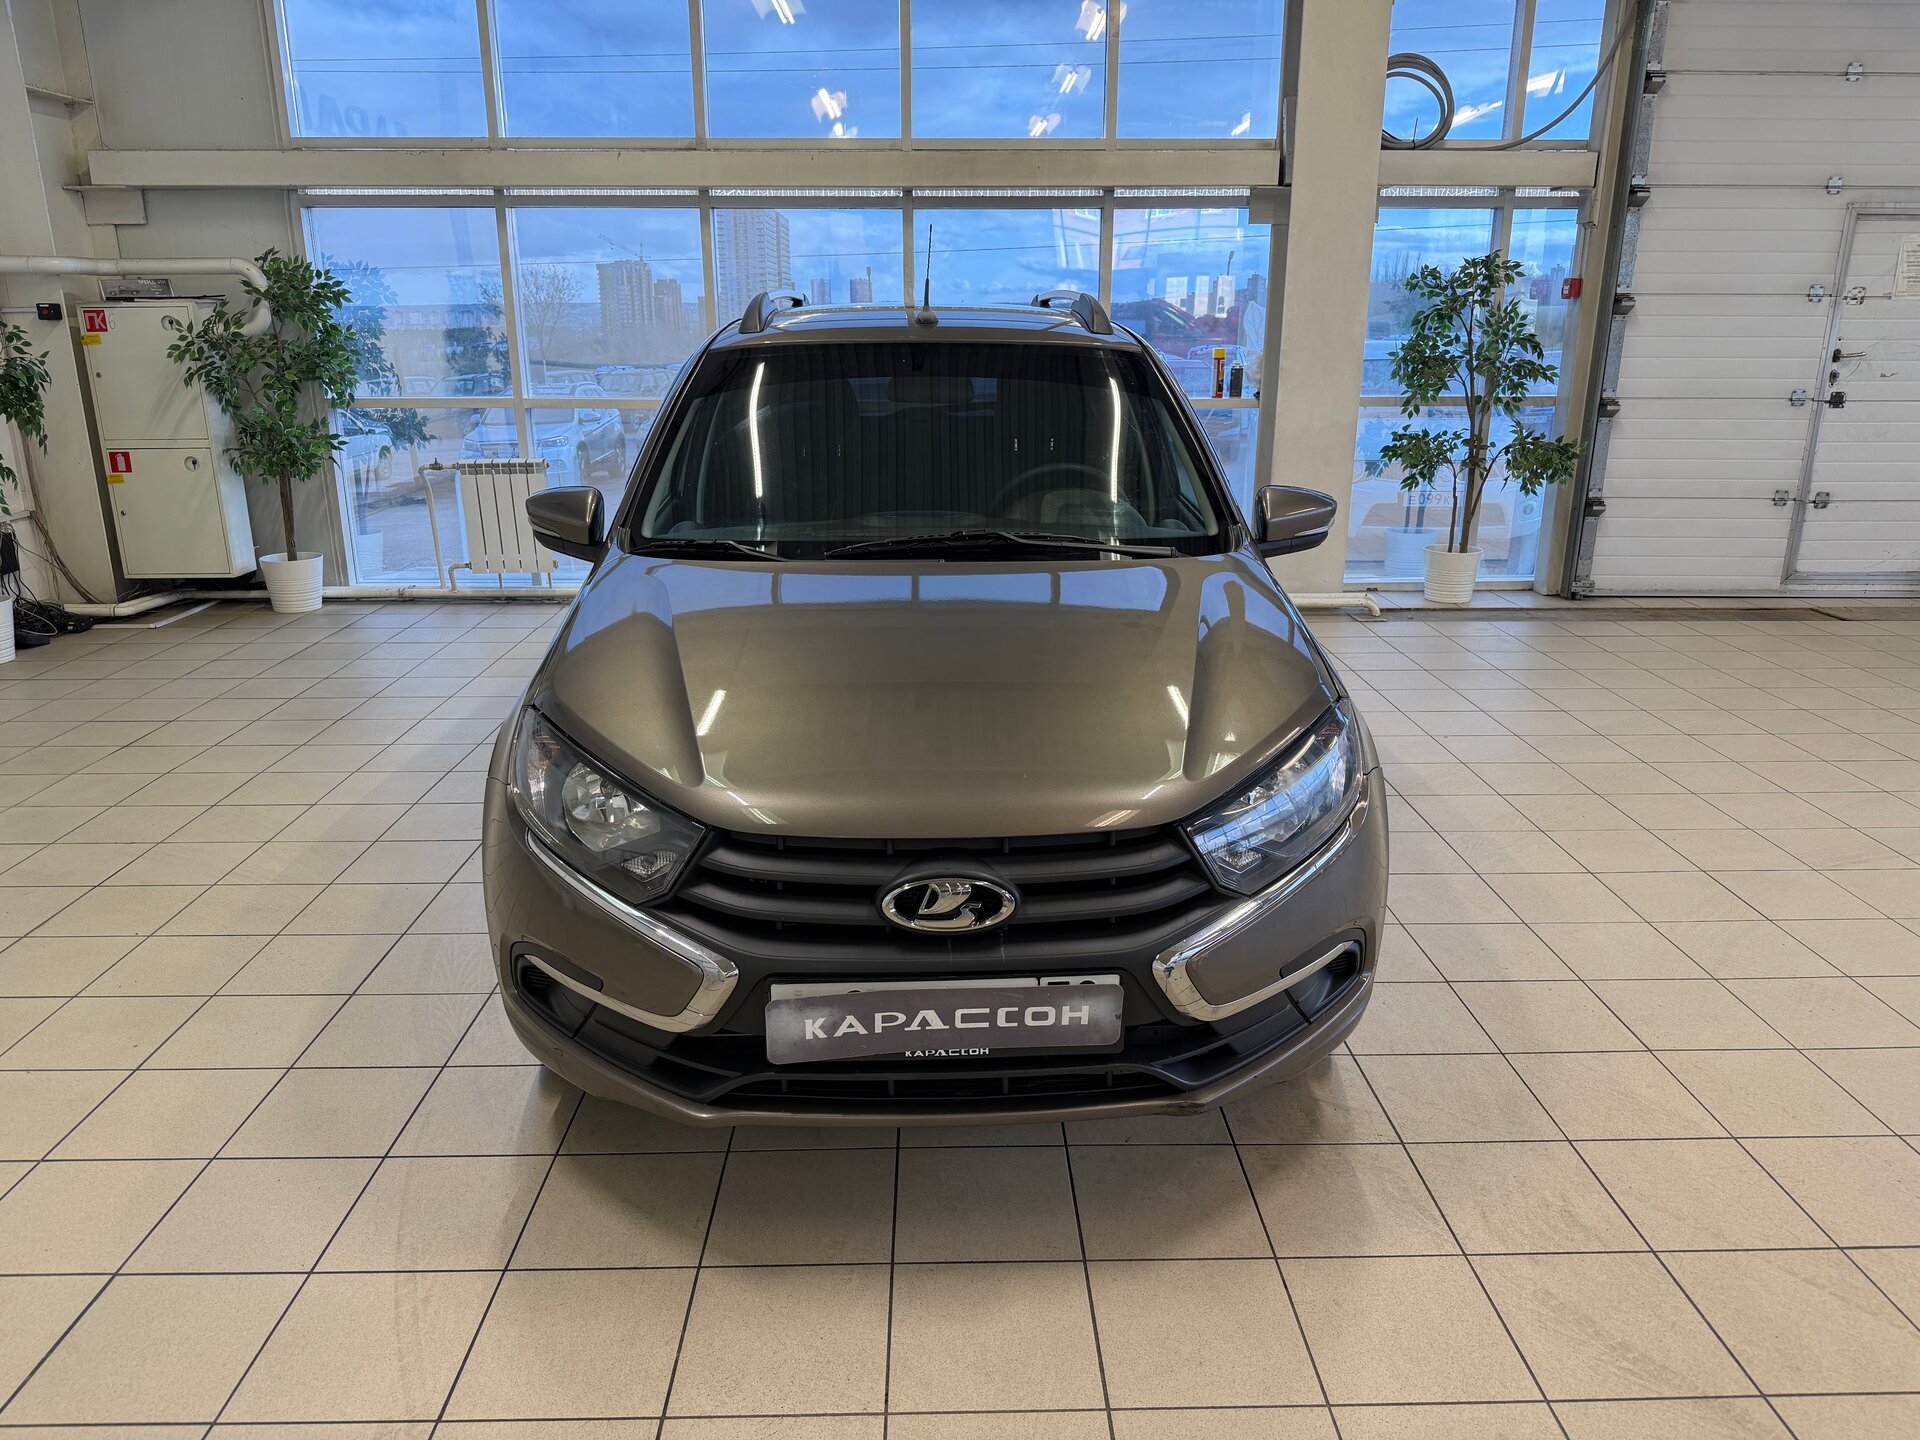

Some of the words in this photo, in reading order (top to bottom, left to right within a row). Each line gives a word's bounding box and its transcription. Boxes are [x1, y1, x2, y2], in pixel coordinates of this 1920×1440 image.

[84, 312, 107, 330] ПК
[1408, 493, 1456, 505] Е099К
[803, 1005, 1090, 1040] КАРАССОН
[905, 1047, 989, 1057] КАРАССОН
